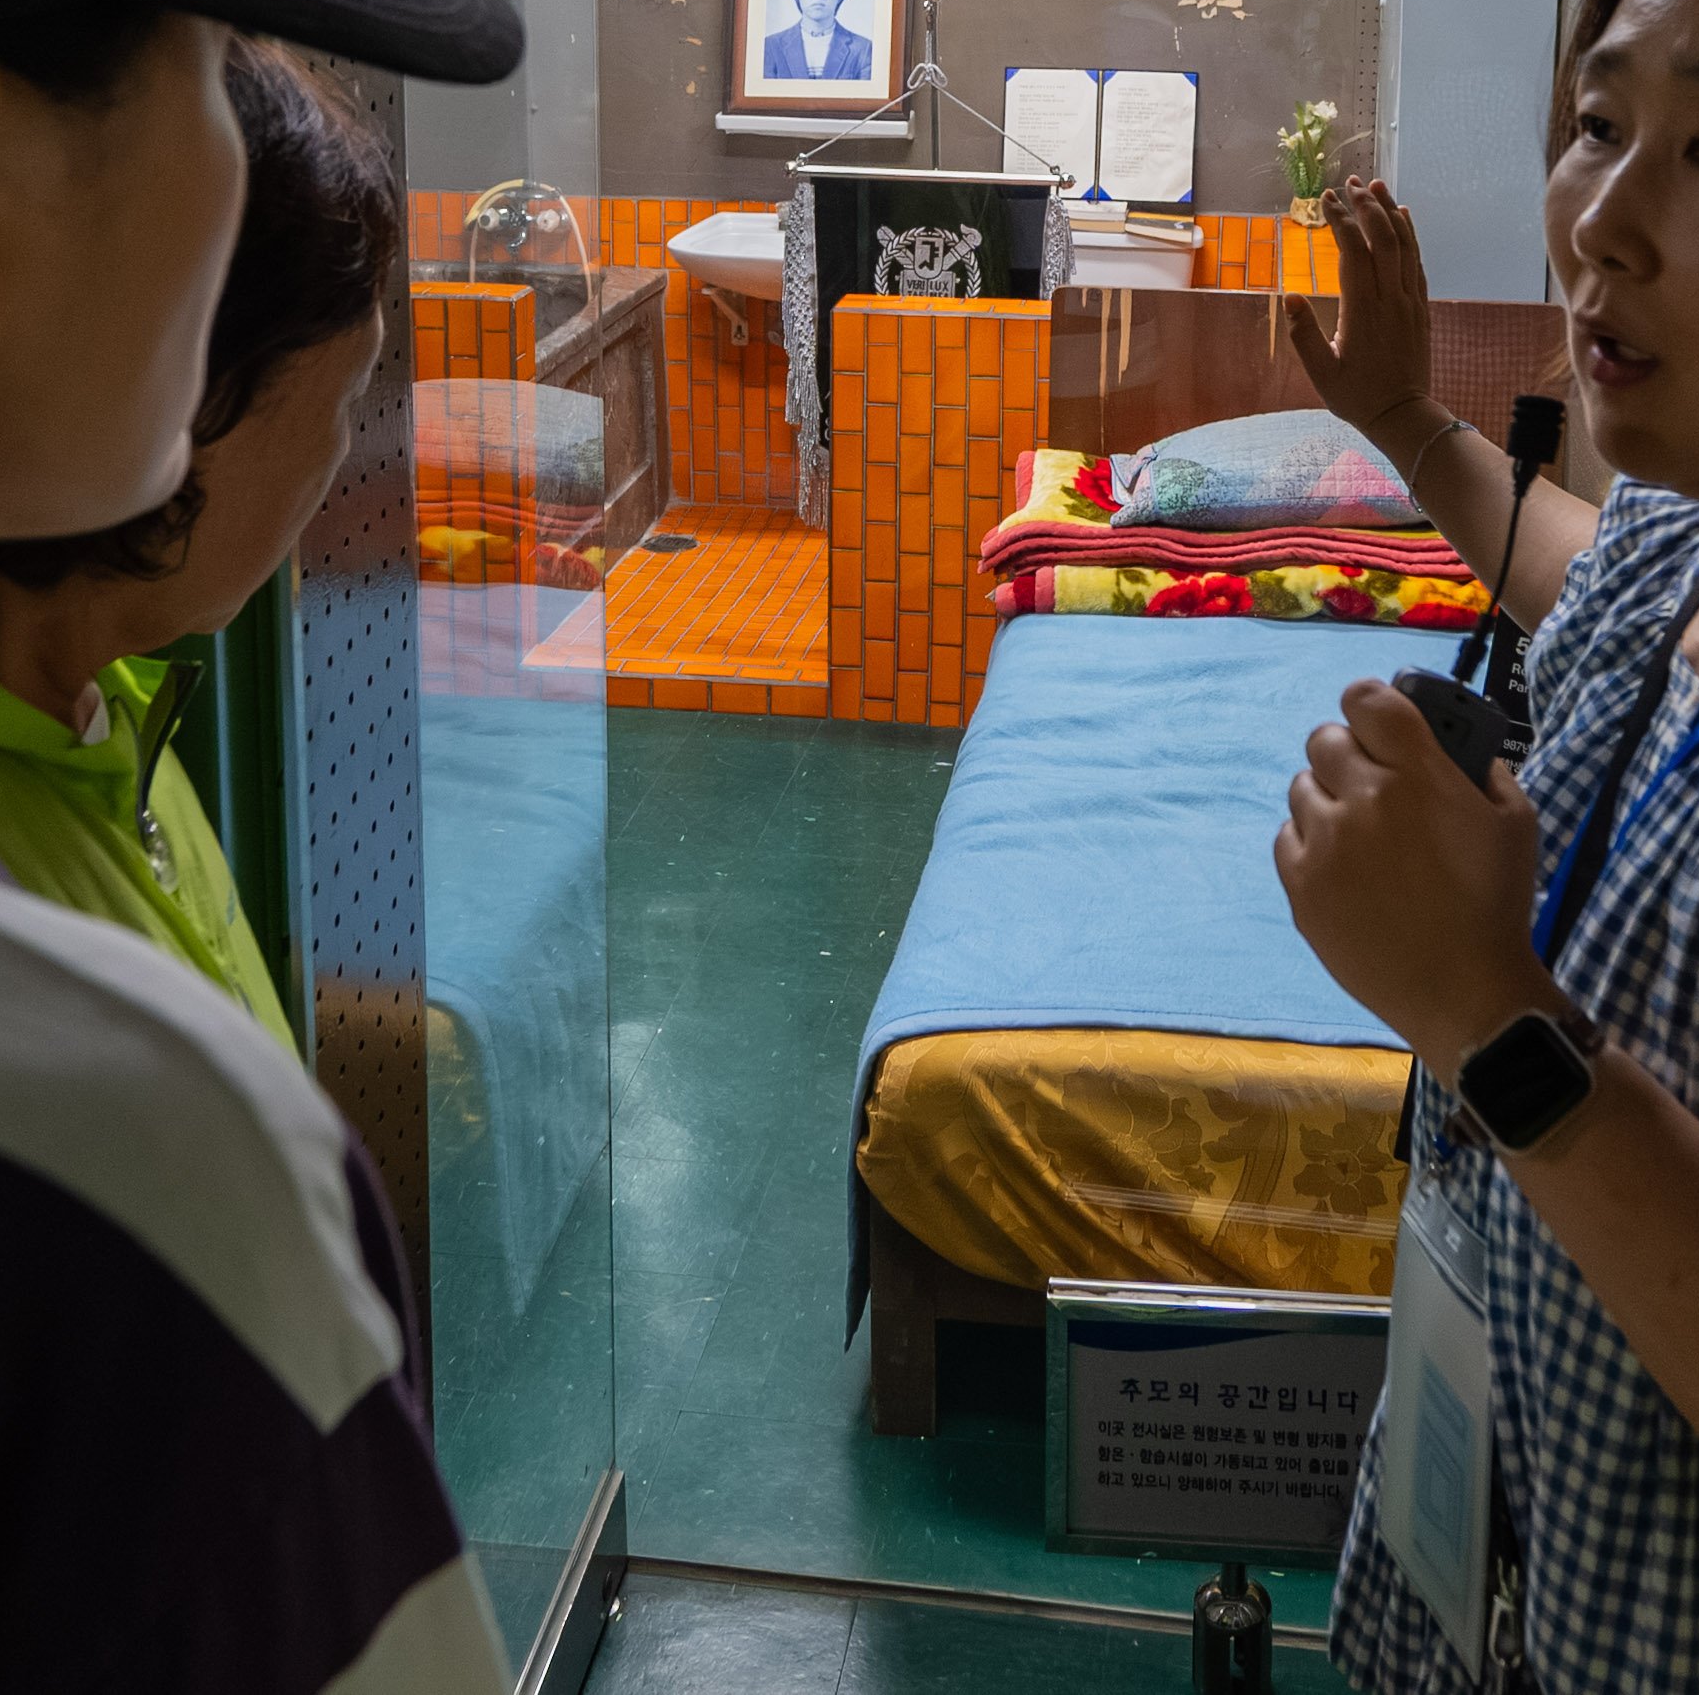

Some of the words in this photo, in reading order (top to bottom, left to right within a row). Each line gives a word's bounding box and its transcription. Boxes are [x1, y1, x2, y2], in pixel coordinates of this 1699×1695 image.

[907, 279, 924, 290] VERI
[930, 281, 948, 292] LUX
[1508, 679, 1529, 694] Par
[1119, 1378, 1200, 1407] 추모의
[1217, 1384, 1359, 1415] 공간입니다
[1098, 1421, 1125, 1437] 이곳
[1132, 1422, 1186, 1440] 전시실은
[1275, 1456, 1301, 1473] 있어
[1098, 1471, 1125, 1488] 하고
[1131, 1473, 1171, 1492] 있으니
[1178, 1475, 1232, 1494] 양해하여
[1238, 1480, 1279, 1497] 주시기
